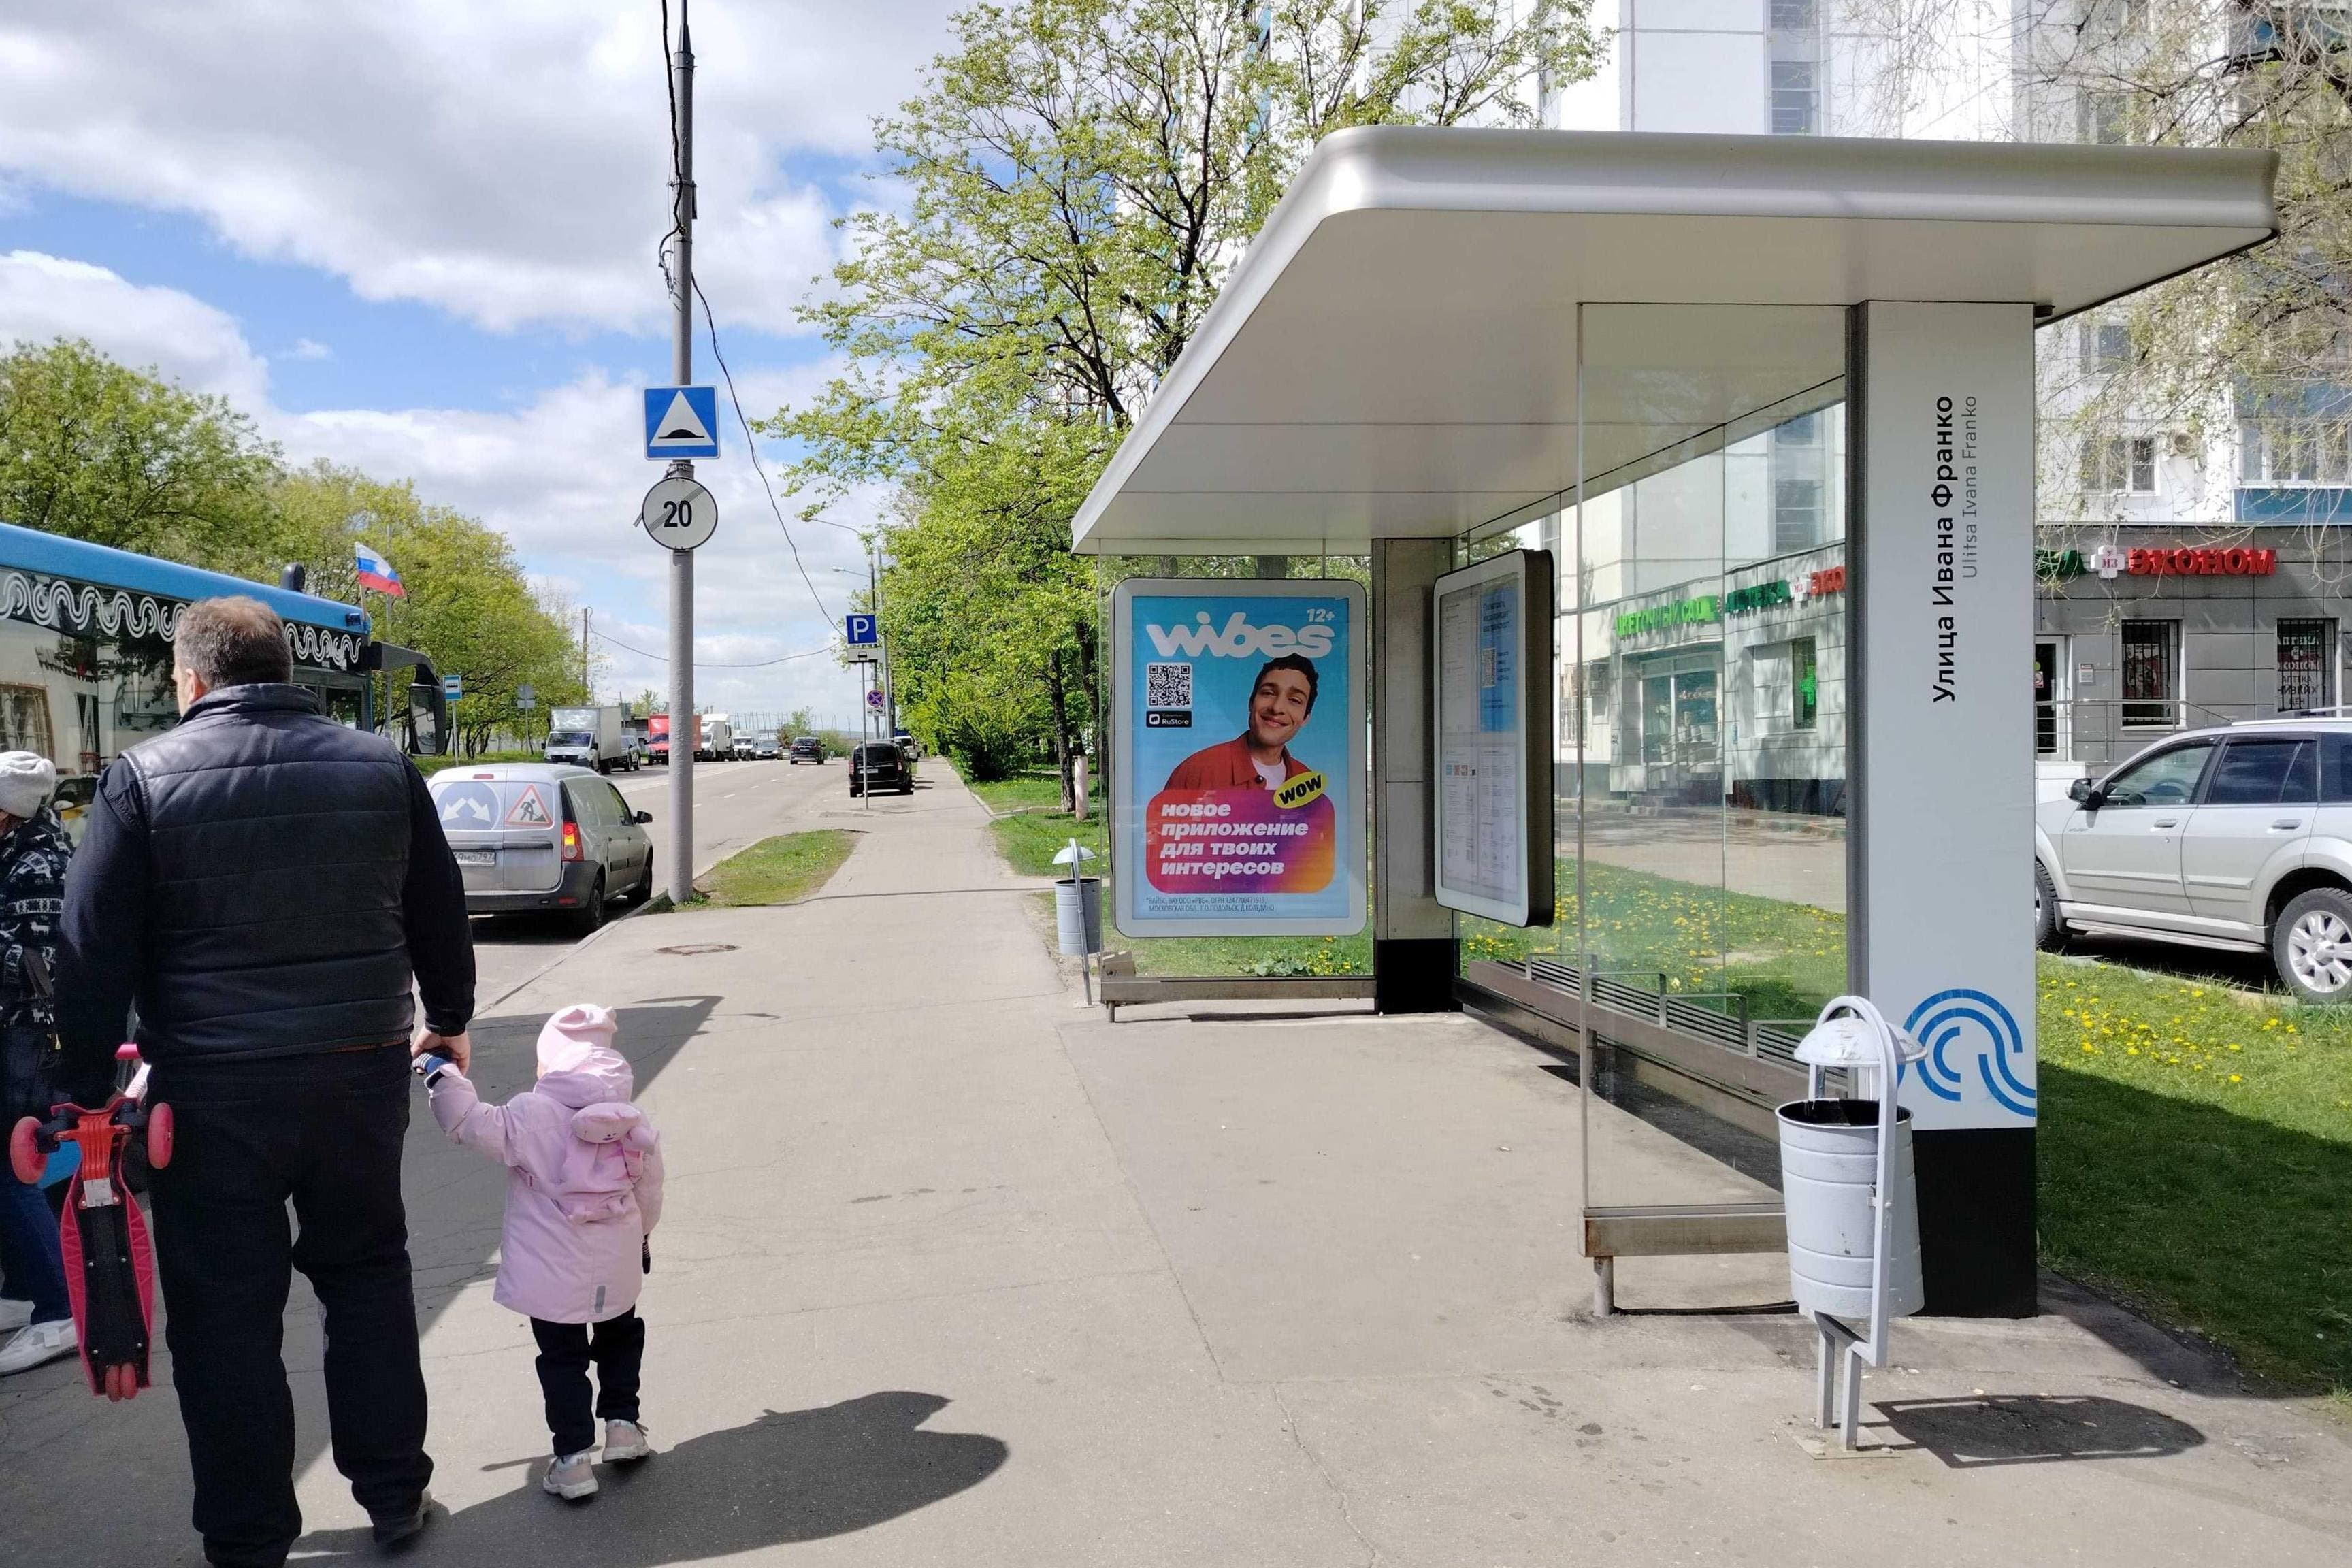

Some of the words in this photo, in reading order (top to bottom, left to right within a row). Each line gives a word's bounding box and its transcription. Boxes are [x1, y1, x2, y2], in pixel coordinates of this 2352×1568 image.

[1961, 395, 1977, 459] Franko
[1930, 396, 1958, 508] Франко
[1961, 466, 1978, 517] Ivana
[663, 500, 693, 528] 20
[1931, 517, 1954, 605] Ивана
[1962, 523, 1978, 578] Ulitsa
[2127, 549, 2276, 576] ЭКОНОМ
[1724, 580, 1792, 613] АПТЕКА
[1307, 608, 1336, 623] 12+
[1616, 599, 1682, 637] ЦВЕТОЧНЫЙ
[1932, 616, 1958, 703] Улица
[1161, 804, 1232, 817] новое
[1161, 823, 1309, 840] приложение
[1160, 843, 1205, 858] для
[1210, 843, 1277, 855] твоих
[1161, 862, 1285, 879] интересов
